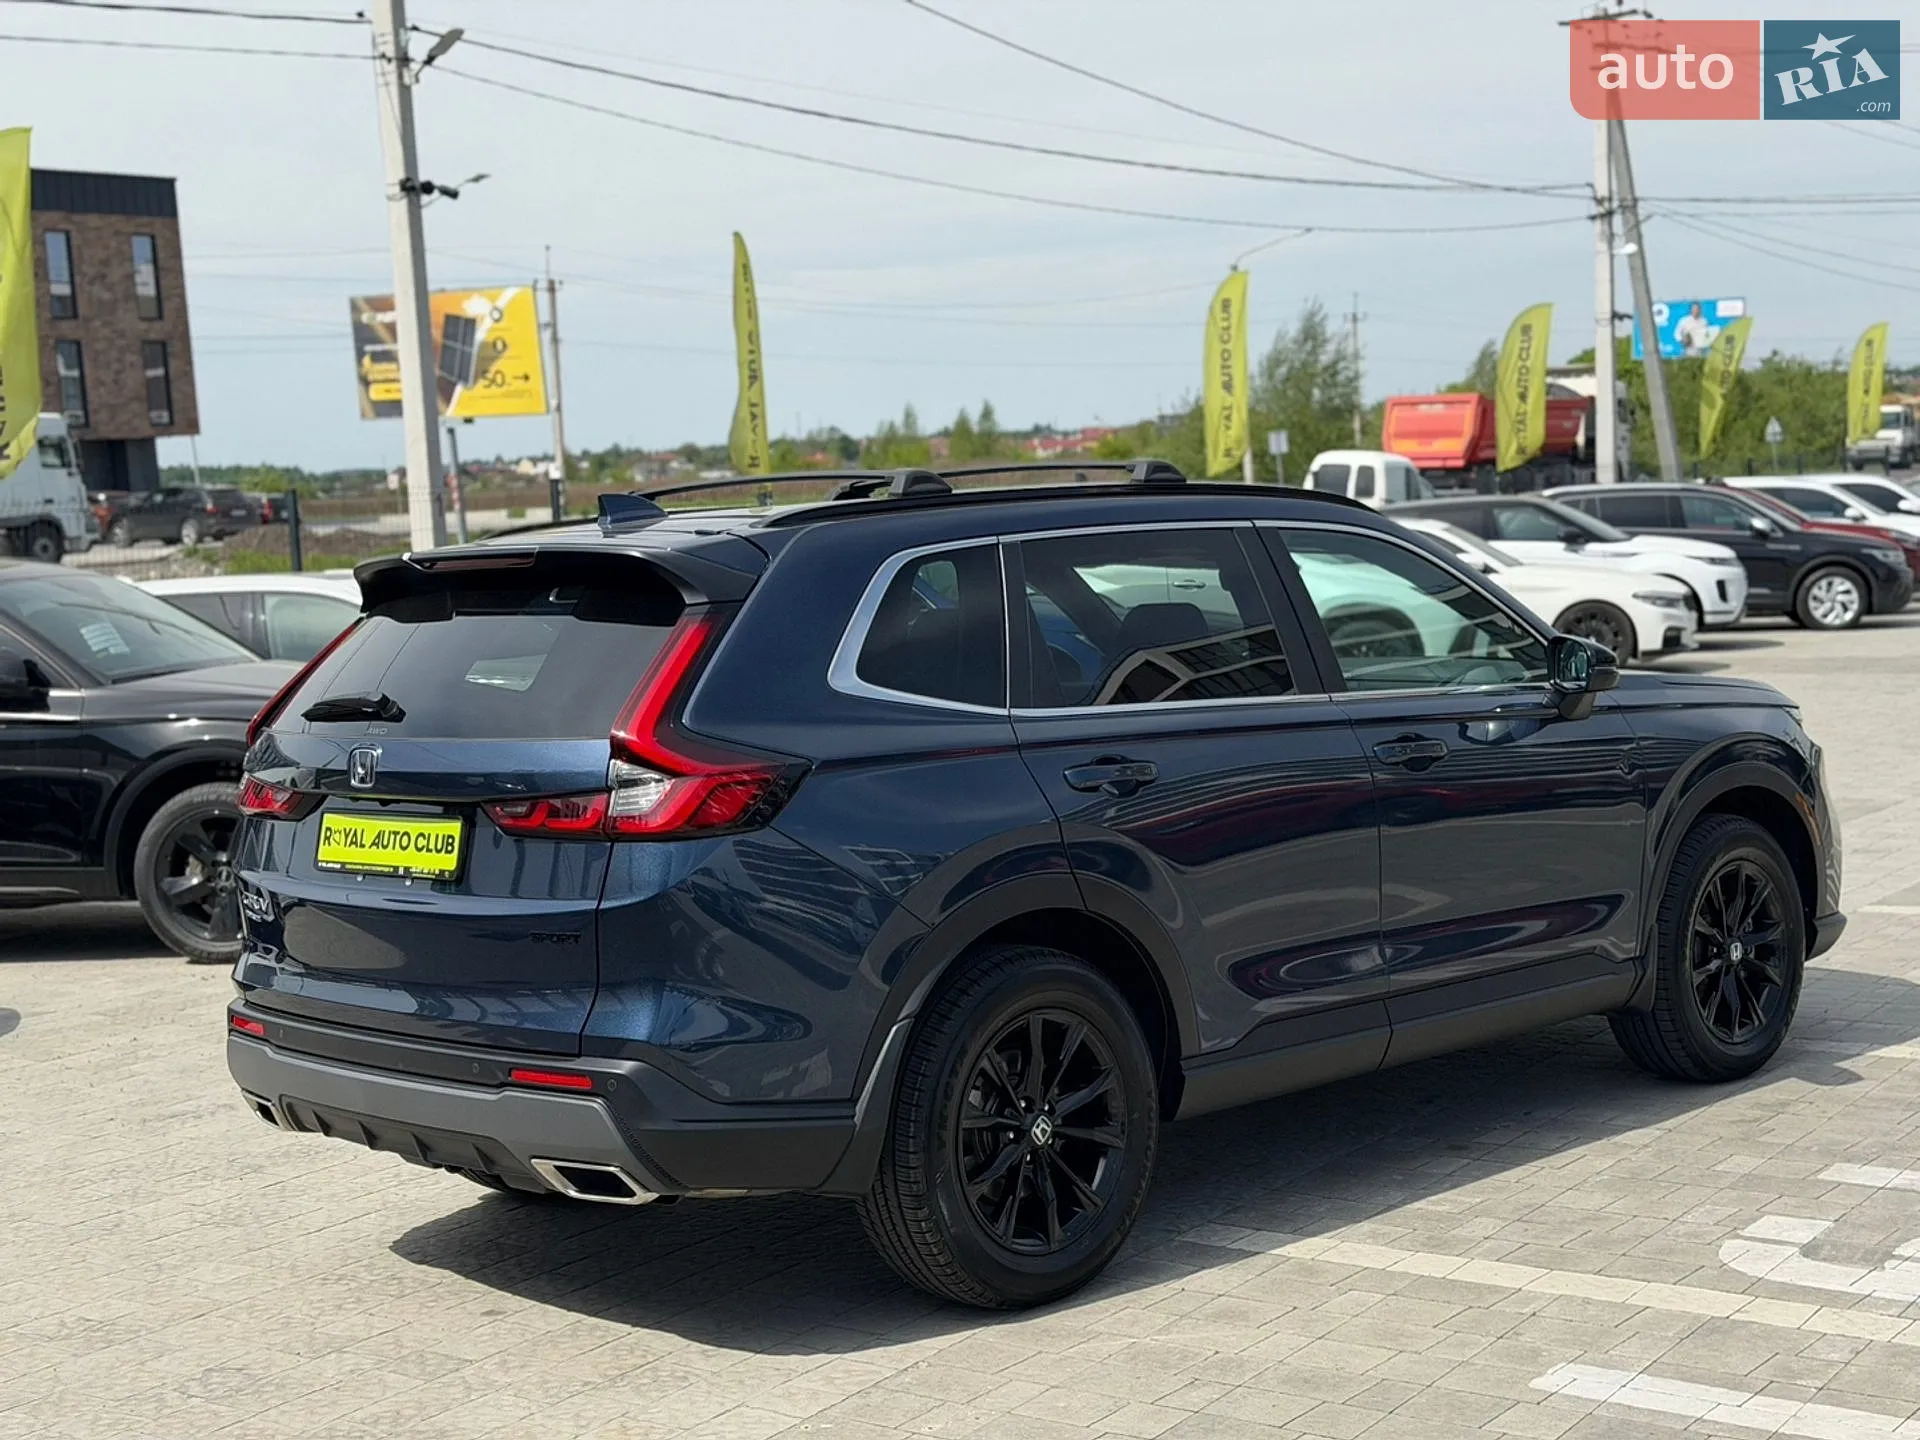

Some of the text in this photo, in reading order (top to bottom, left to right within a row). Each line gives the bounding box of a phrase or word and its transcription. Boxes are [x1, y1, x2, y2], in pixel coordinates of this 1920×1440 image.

[1518, 323, 1533, 361] CLUB
[1218, 297, 1235, 458] RYAL AUTO CLUB
[1515, 411, 1528, 456] RYAL
[369, 829, 411, 851] AUTO
[414, 832, 456, 855] CLUB
